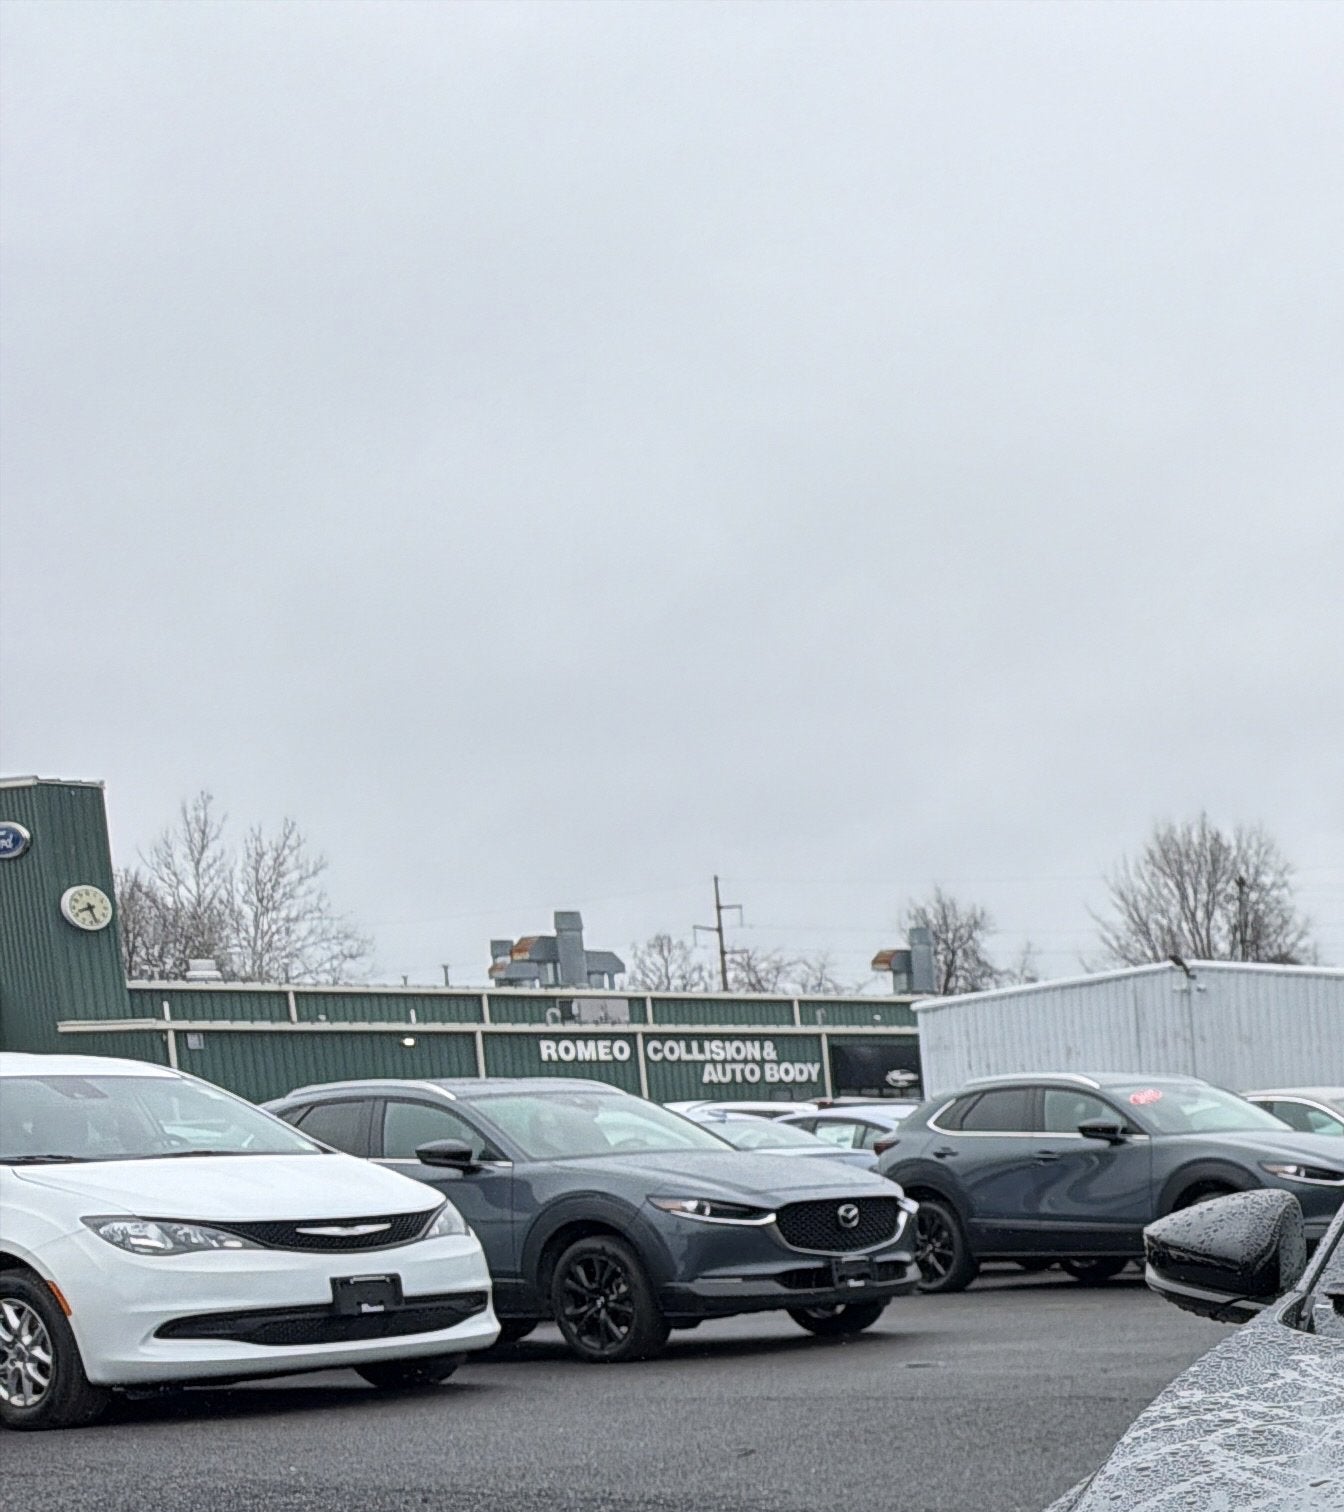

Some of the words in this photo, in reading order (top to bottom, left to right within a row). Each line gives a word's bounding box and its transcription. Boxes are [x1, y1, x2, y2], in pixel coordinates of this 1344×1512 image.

[539, 1040, 631, 1062] ROMEO
[647, 1040, 763, 1062] COLLISION
[763, 1041, 778, 1061] &
[702, 1063, 762, 1084] AUTO
[764, 1062, 821, 1083] BODY
